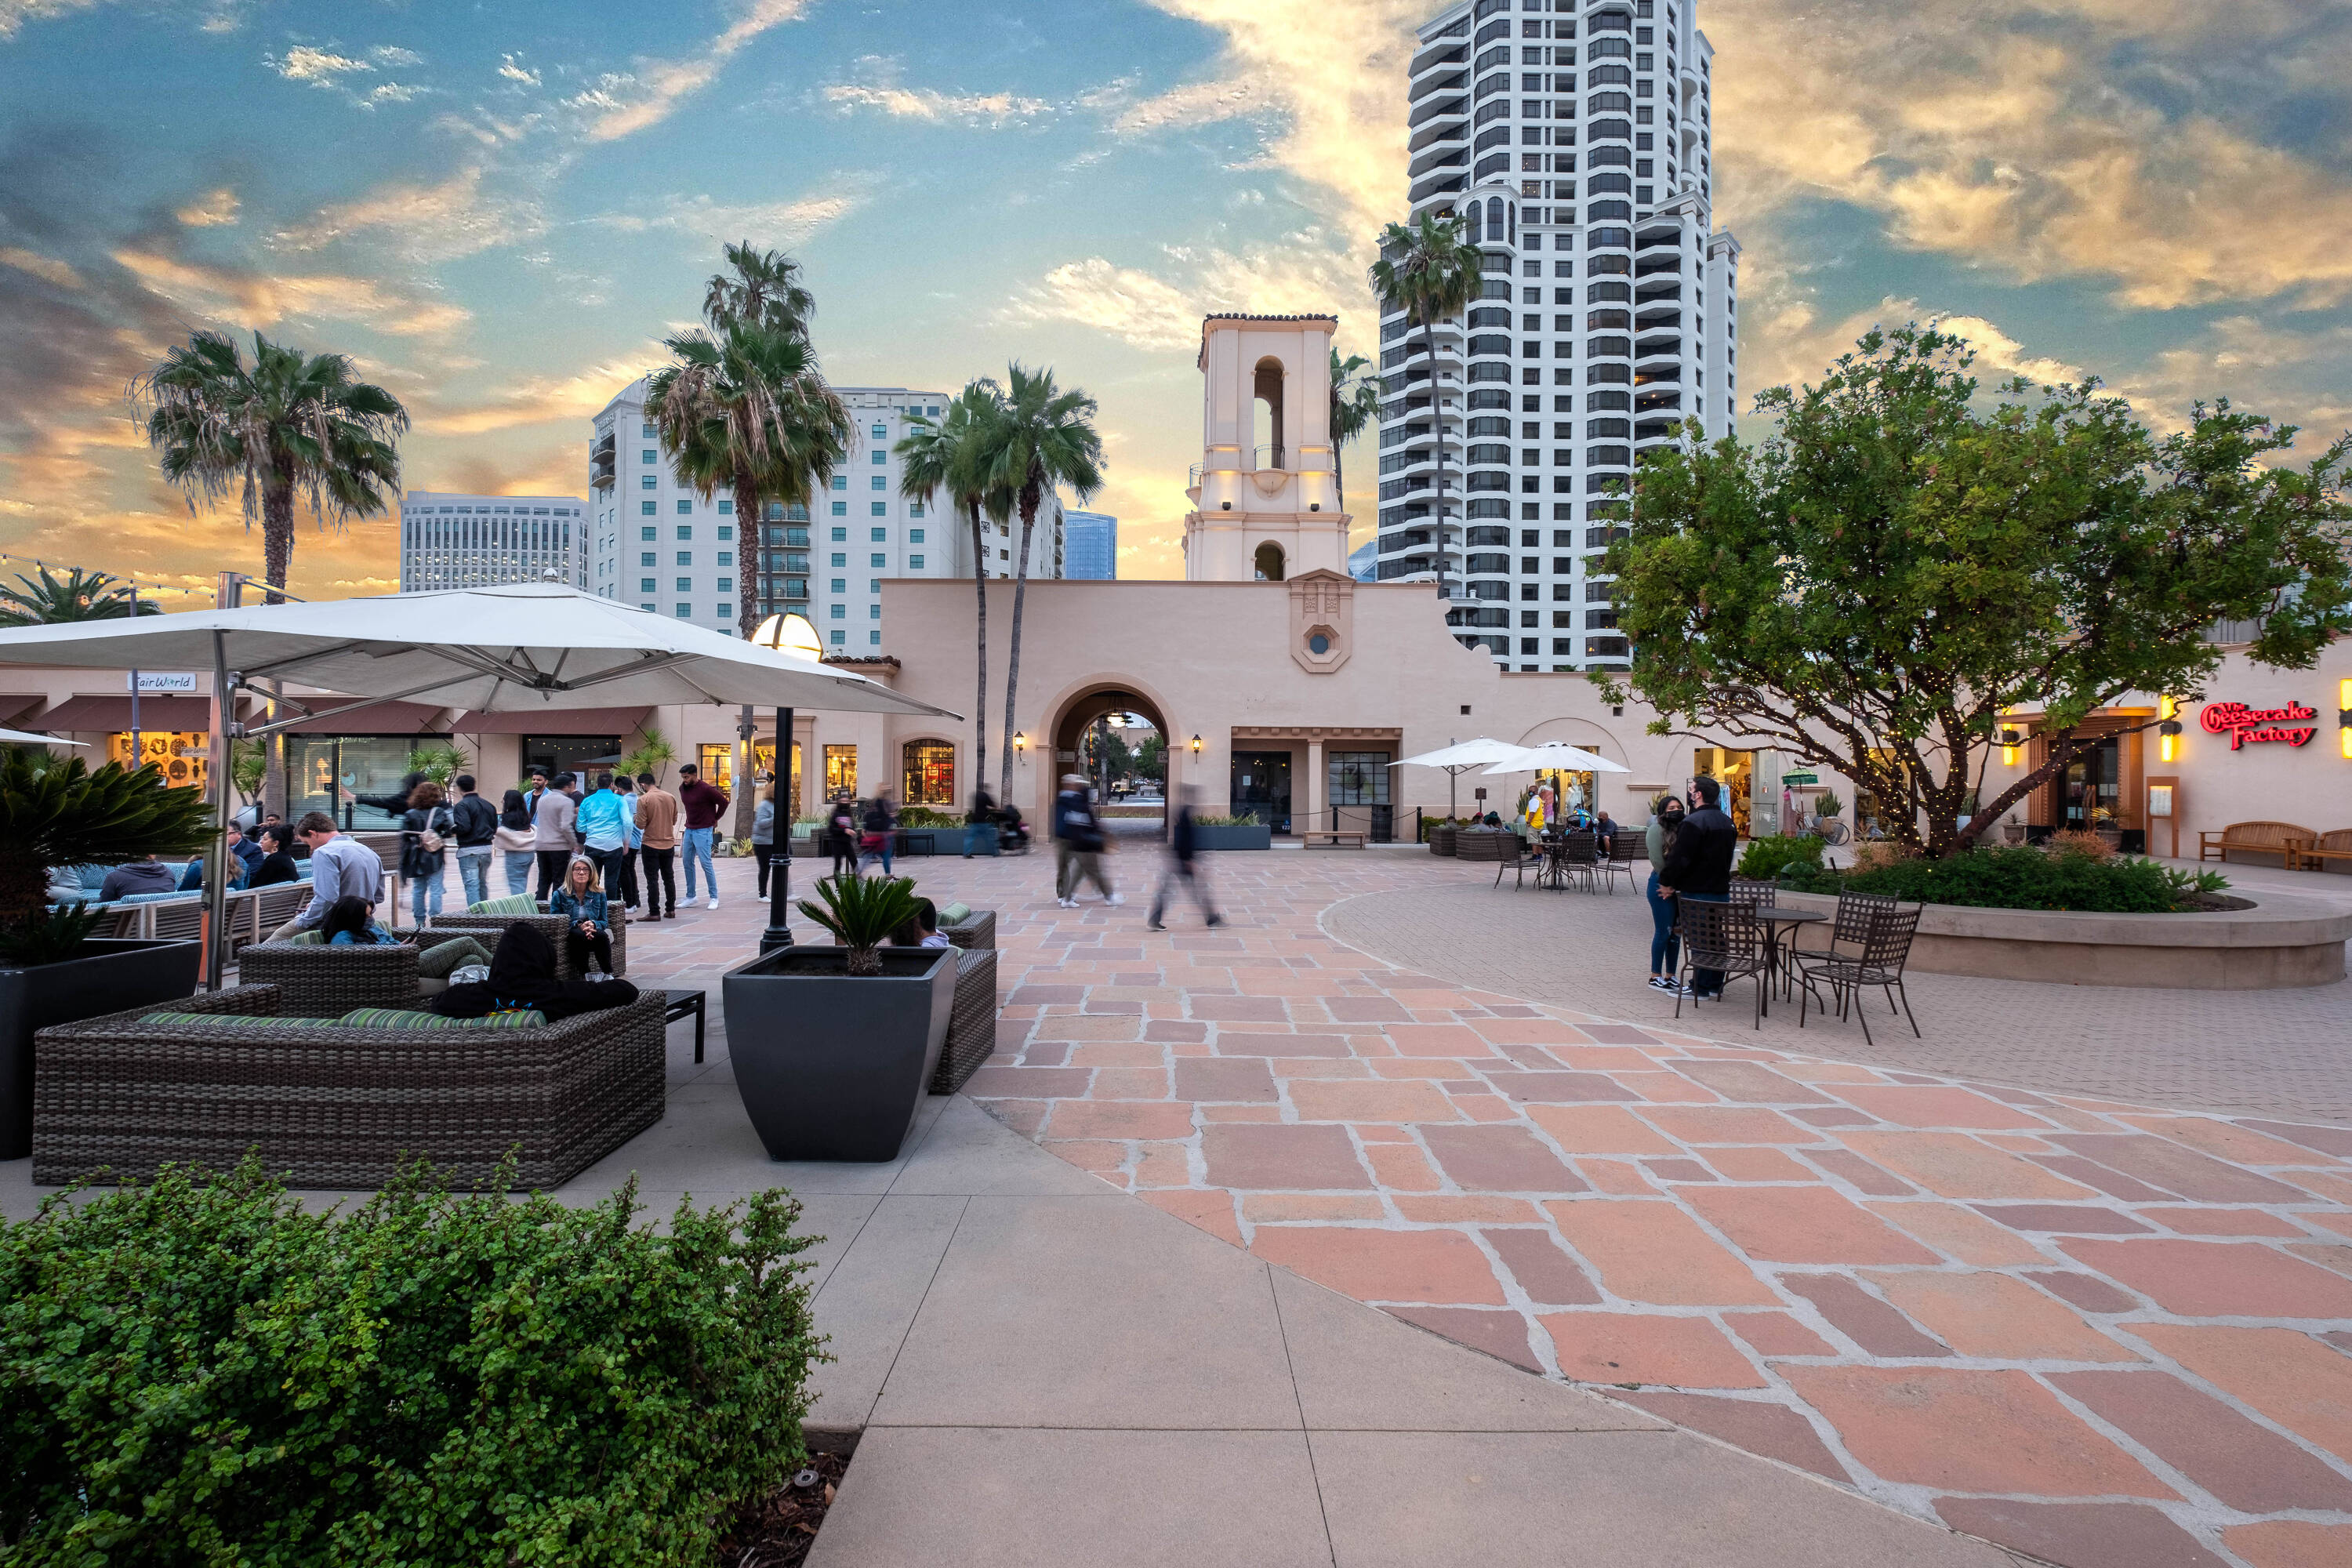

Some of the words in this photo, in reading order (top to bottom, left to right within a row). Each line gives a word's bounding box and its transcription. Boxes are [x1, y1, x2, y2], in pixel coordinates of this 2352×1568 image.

[2201, 701, 2314, 733] Cheesecake
[2227, 702, 2245, 711] The
[2222, 721, 2314, 750] Factory
